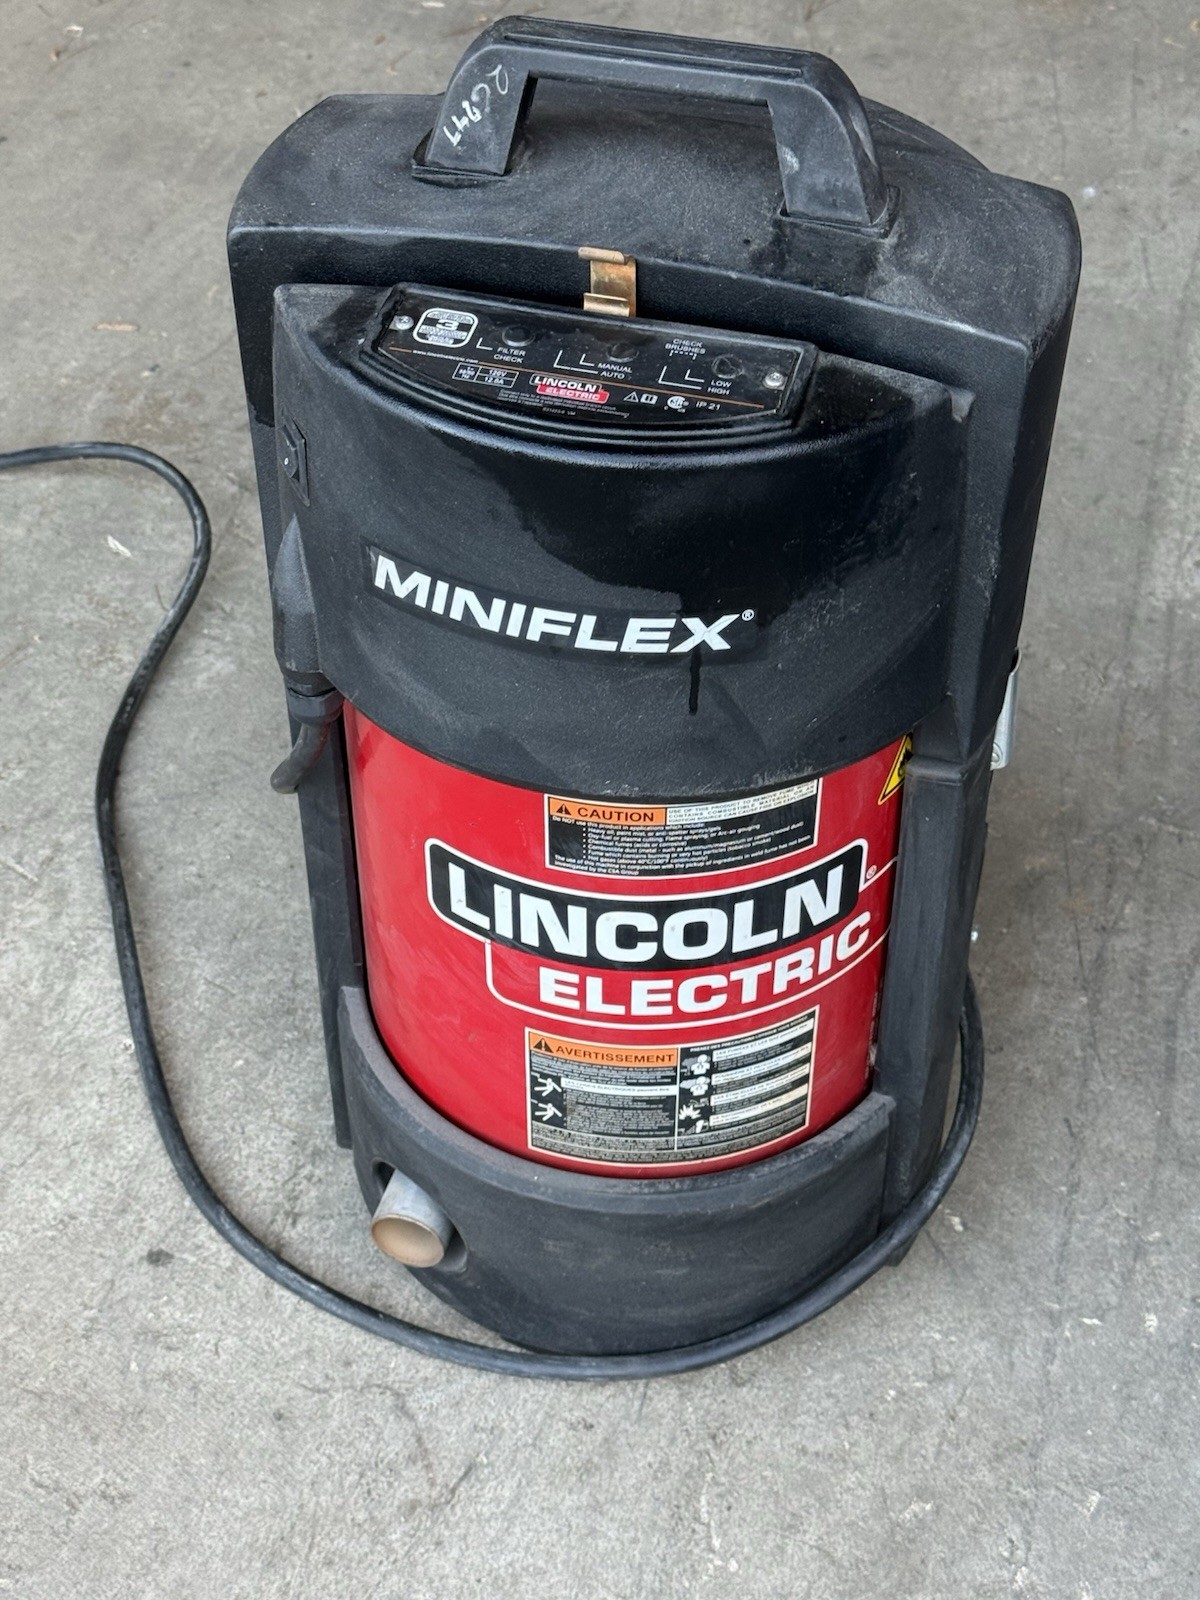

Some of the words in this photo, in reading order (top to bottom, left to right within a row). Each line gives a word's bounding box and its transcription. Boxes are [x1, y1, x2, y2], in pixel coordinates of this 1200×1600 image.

[436, 319, 459, 331] 3
[665, 343, 706, 354] BRUSHES
[672, 338, 703, 348] CHECK
[497, 347, 526, 357] FILTER
[494, 354, 524, 363] CHECK
[598, 362, 632, 373] MANUAL
[600, 371, 625, 380] AUTO
[534, 376, 597, 393] LINCOLN
[710, 380, 732, 388] LOW
[545, 387, 601, 401] ELECTRIC
[708, 387, 731, 395] HIGH
[708, 402, 721, 411] 21
[708, 804, 755, 815] COMBUSTIBLE
[711, 802, 740, 810] PRODUCT
[578, 806, 654, 822] CAUTION
[737, 824, 761, 834] gouging
[703, 848, 727, 856] particles
[713, 855, 744, 865] ingredients
[750, 850, 764, 858] weld
[448, 863, 843, 963] LINCOLN
[539, 911, 872, 1017] ELECTRIC
[556, 1046, 675, 1063] AVERTISSEMENT
